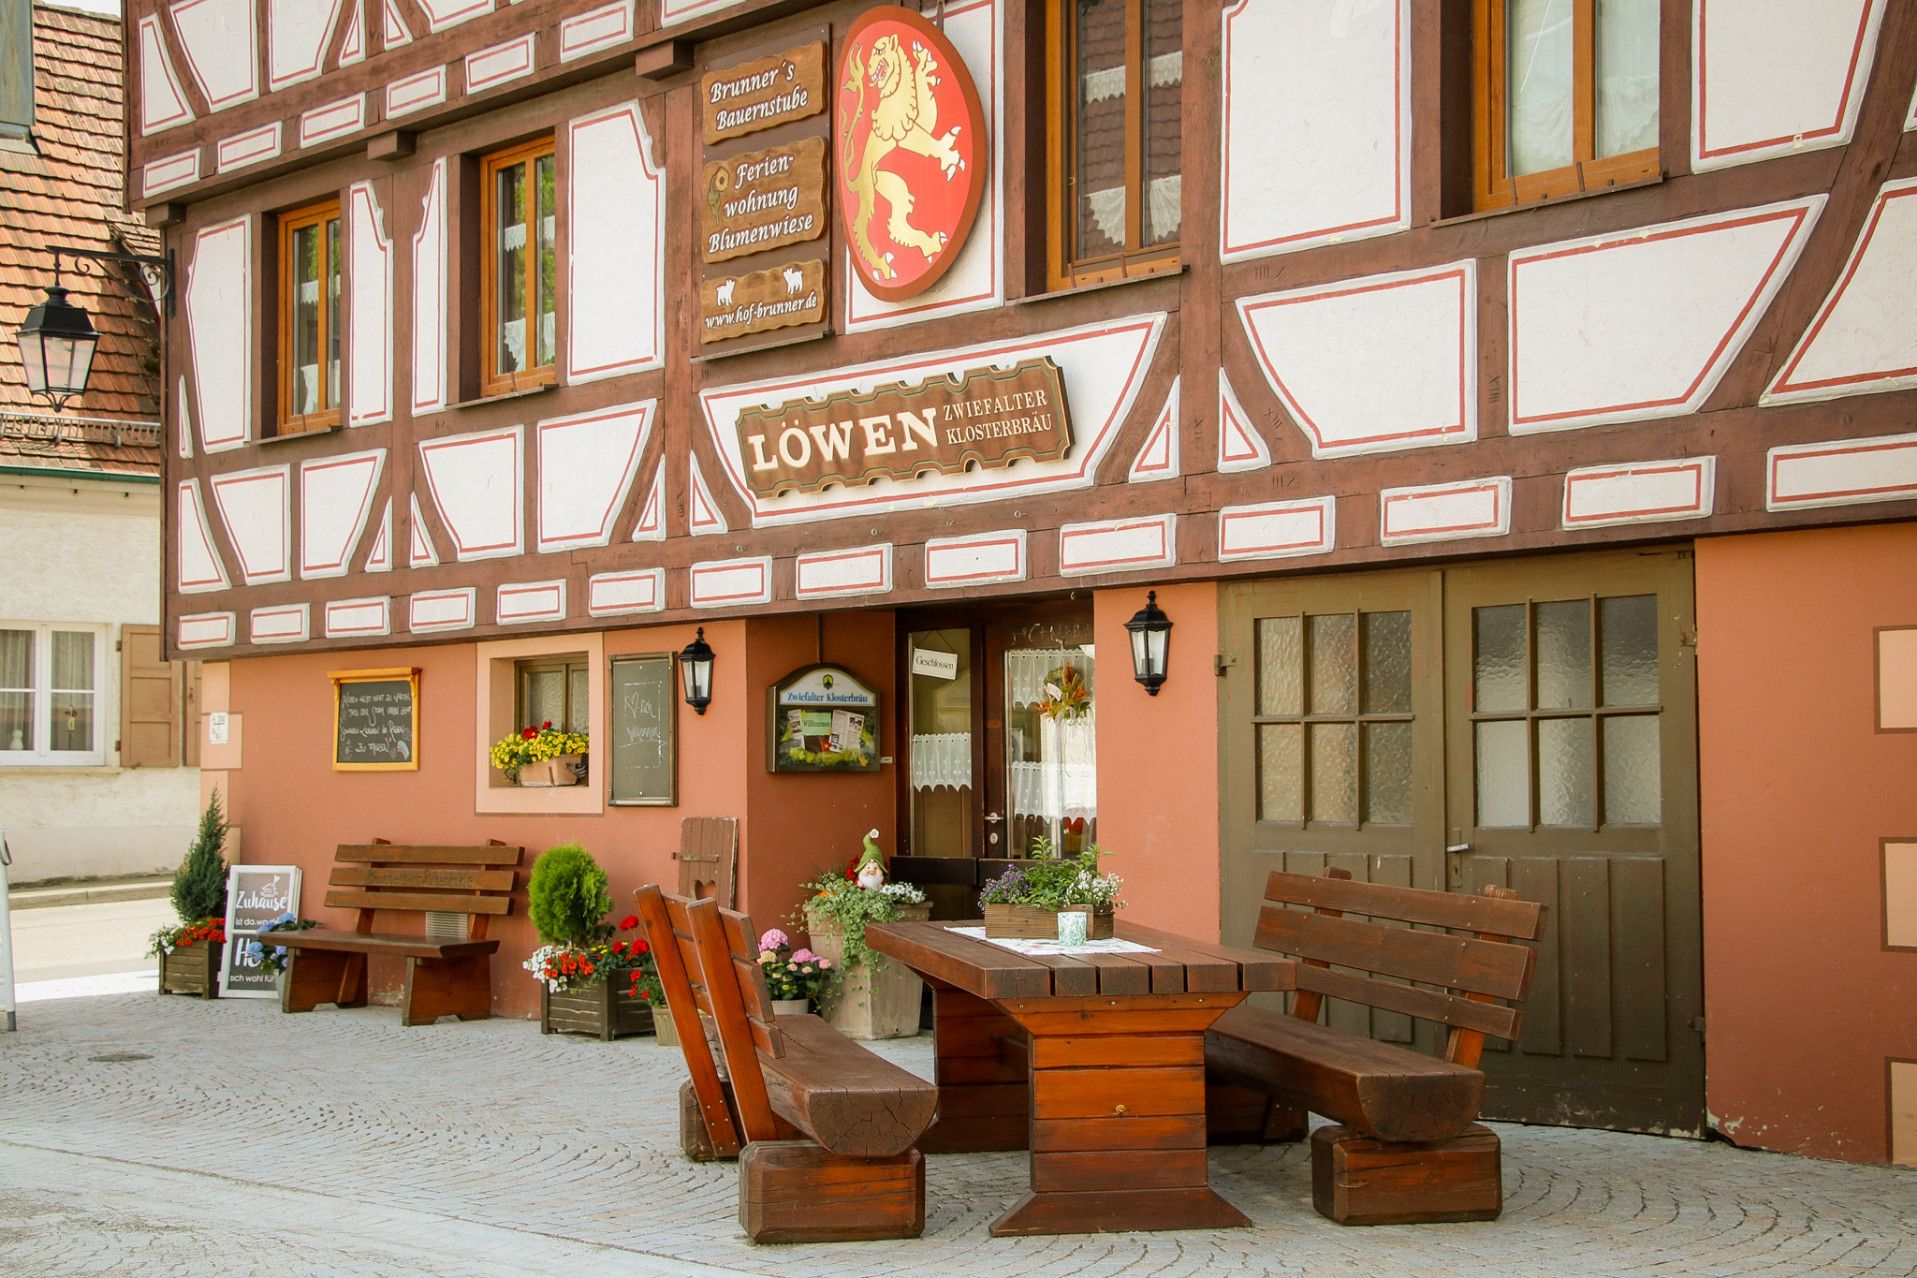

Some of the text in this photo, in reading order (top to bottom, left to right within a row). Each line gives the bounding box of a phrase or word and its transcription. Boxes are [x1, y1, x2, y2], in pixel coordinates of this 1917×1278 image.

[716, 85, 808, 131] Bauernstube
[735, 155, 794, 190] Ferien-
[724, 186, 798, 218] wohnung
[709, 213, 814, 253] Blumenwiese
[705, 291, 817, 328] www.hof-brunner.de
[943, 389, 1048, 421] ZWIEFALTER
[748, 407, 938, 472] LÖWEN
[946, 413, 1052, 445] KLOSTERBRÄU
[915, 655, 954, 670] Geschlossen
[787, 692, 868, 703] Zwiefalter Klosterbräu
[235, 891, 289, 911] Zuhause
[246, 974, 263, 983] wohl
